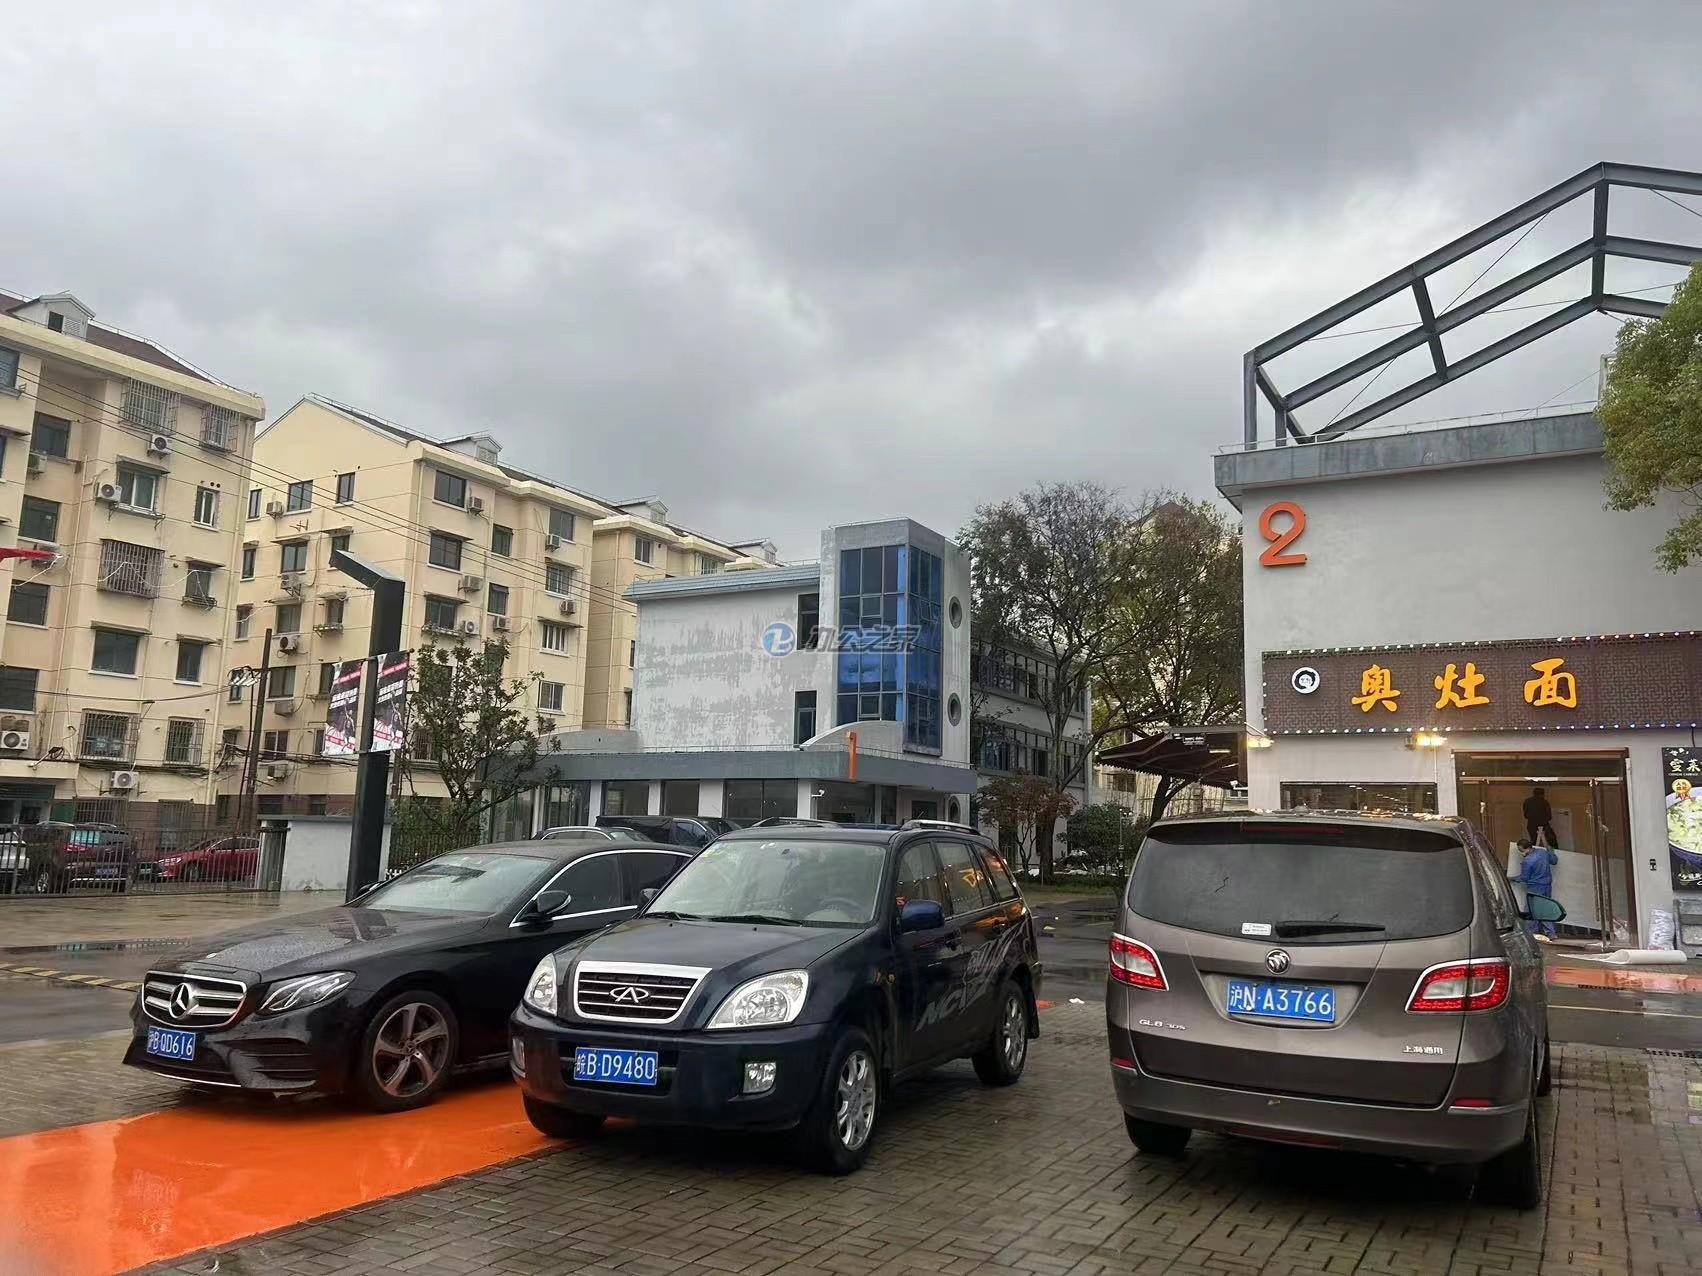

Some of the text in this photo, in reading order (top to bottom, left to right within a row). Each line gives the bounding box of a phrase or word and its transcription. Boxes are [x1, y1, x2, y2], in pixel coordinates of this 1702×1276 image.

[1259, 501, 1307, 567] 2
[1351, 657, 1577, 712] 奥灶面
